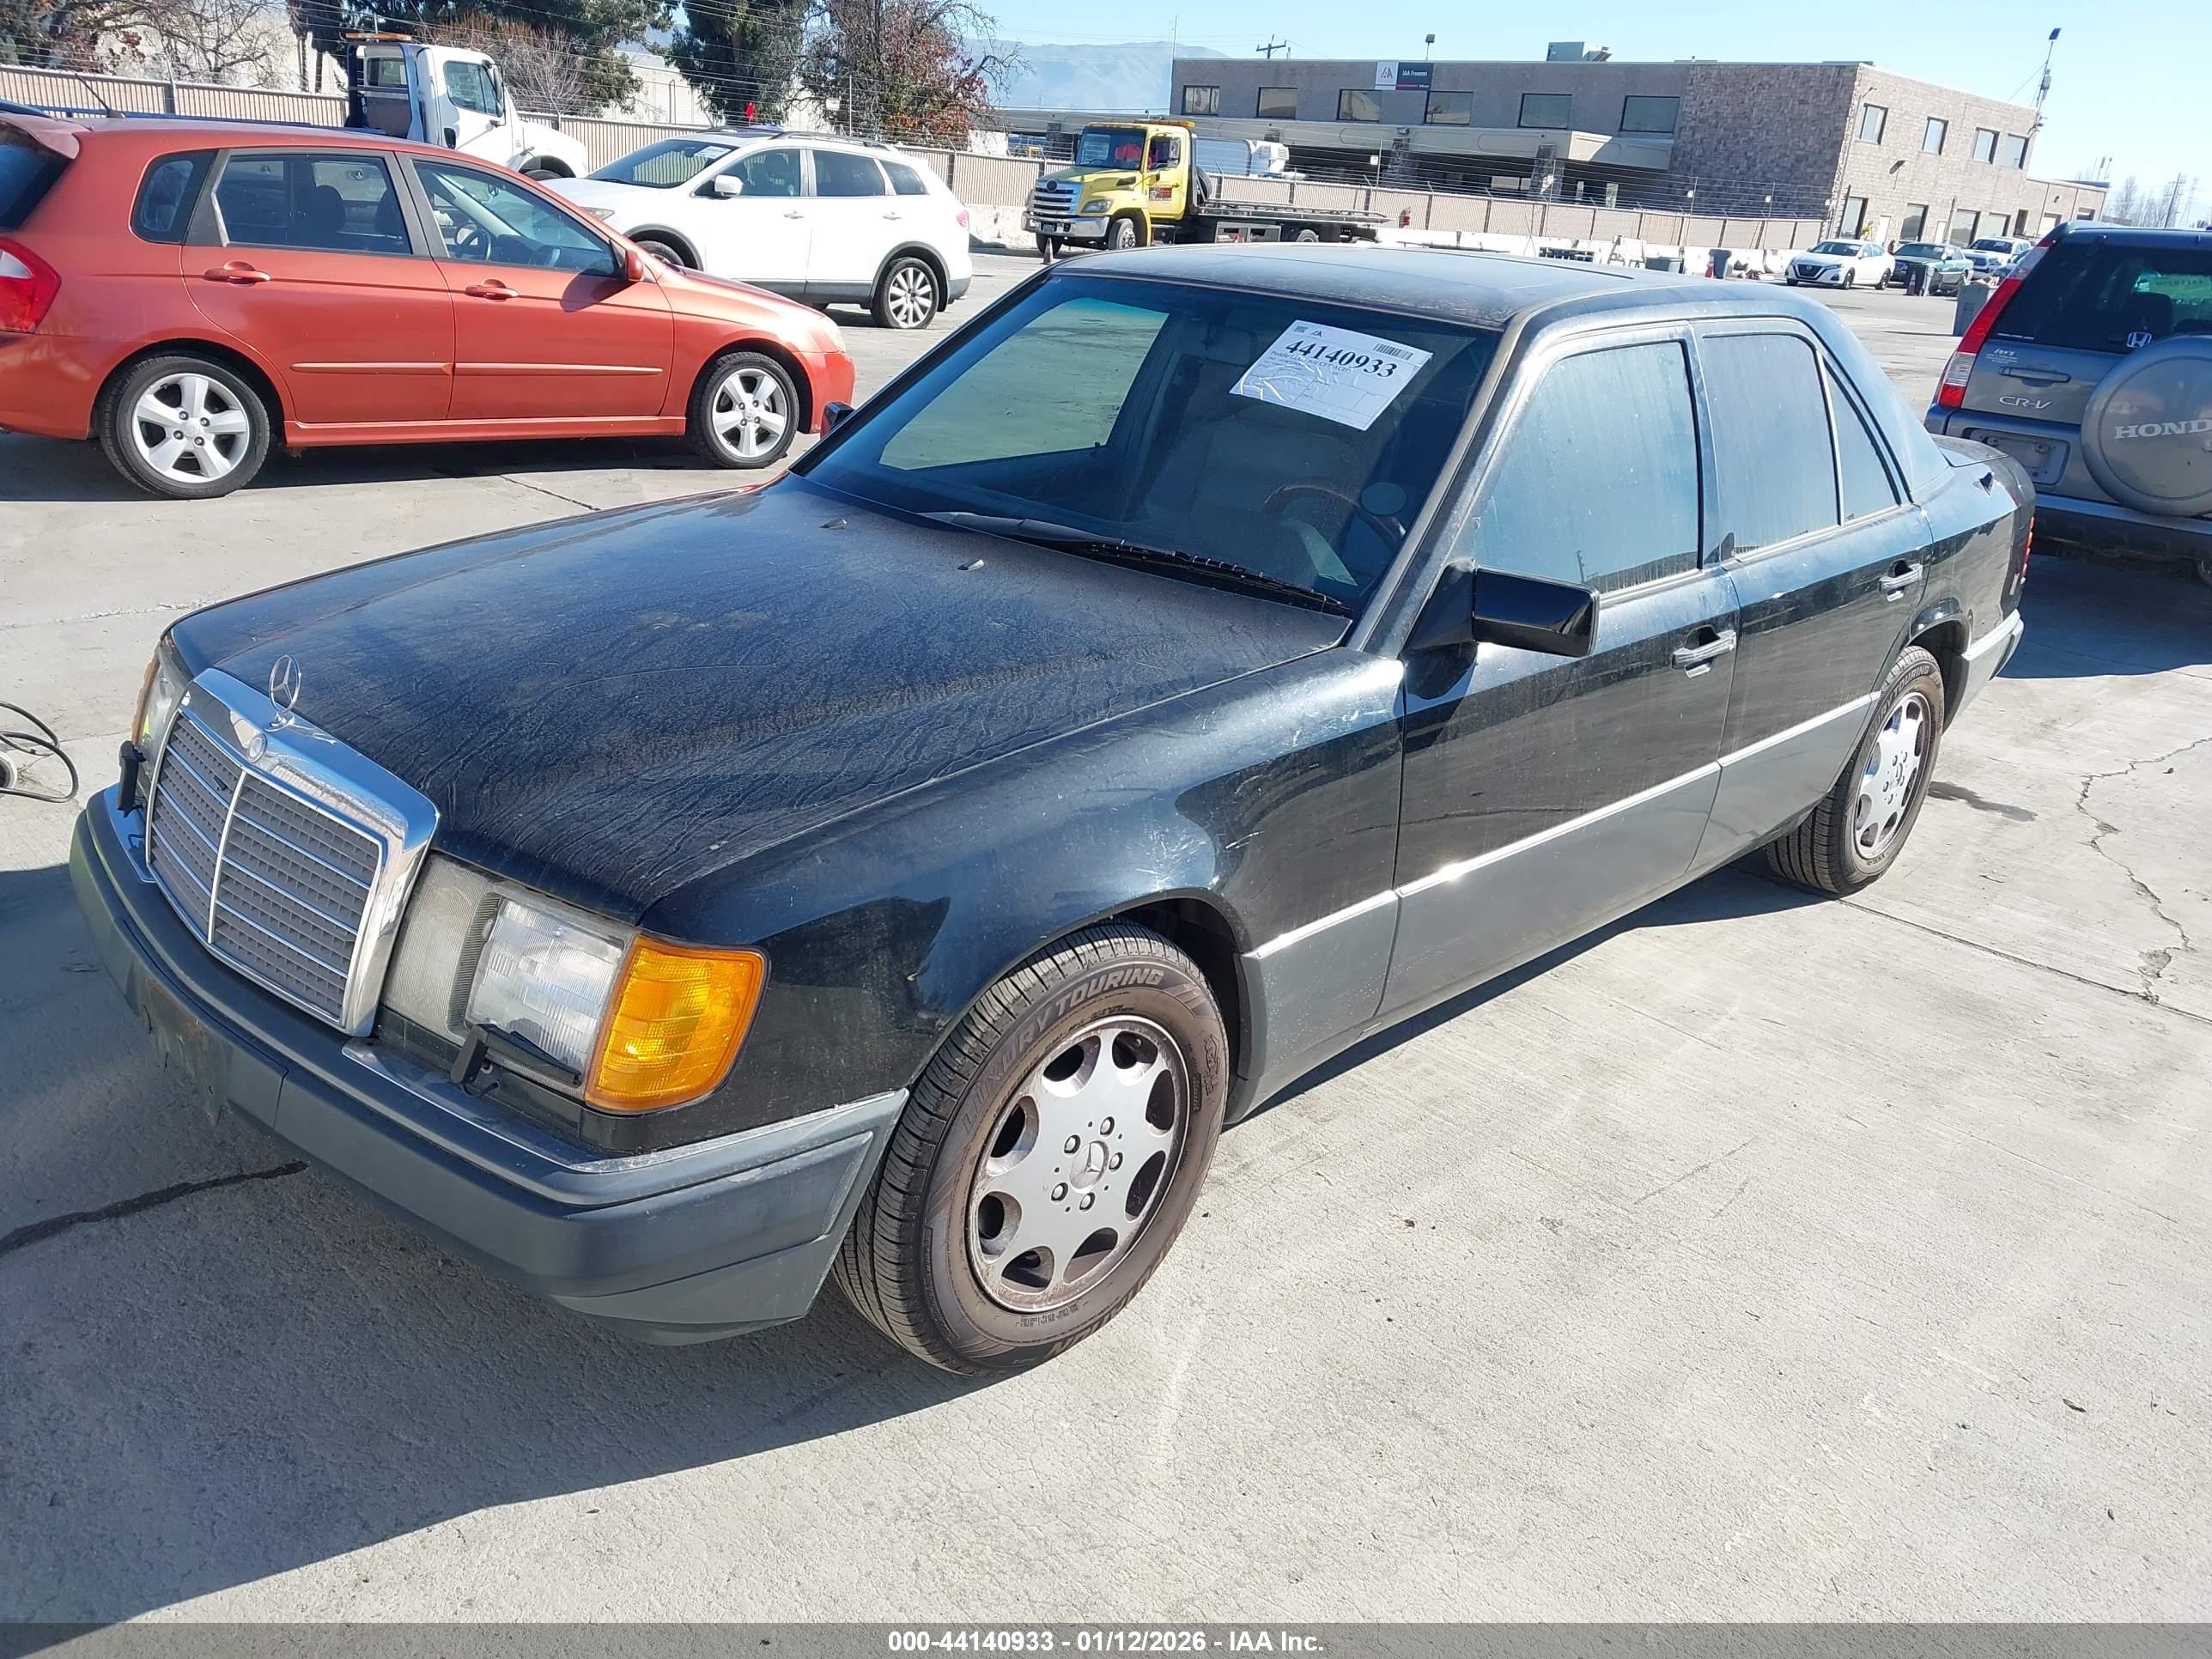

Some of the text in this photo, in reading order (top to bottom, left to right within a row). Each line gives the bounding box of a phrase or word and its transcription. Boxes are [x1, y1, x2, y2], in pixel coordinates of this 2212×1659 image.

[1285, 339, 1398, 378] 44140933
[1999, 395, 2052, 410] CR-V
[1893, 665, 1930, 697] TOURING
[962, 967, 1165, 1134] LUXURY TOURING
